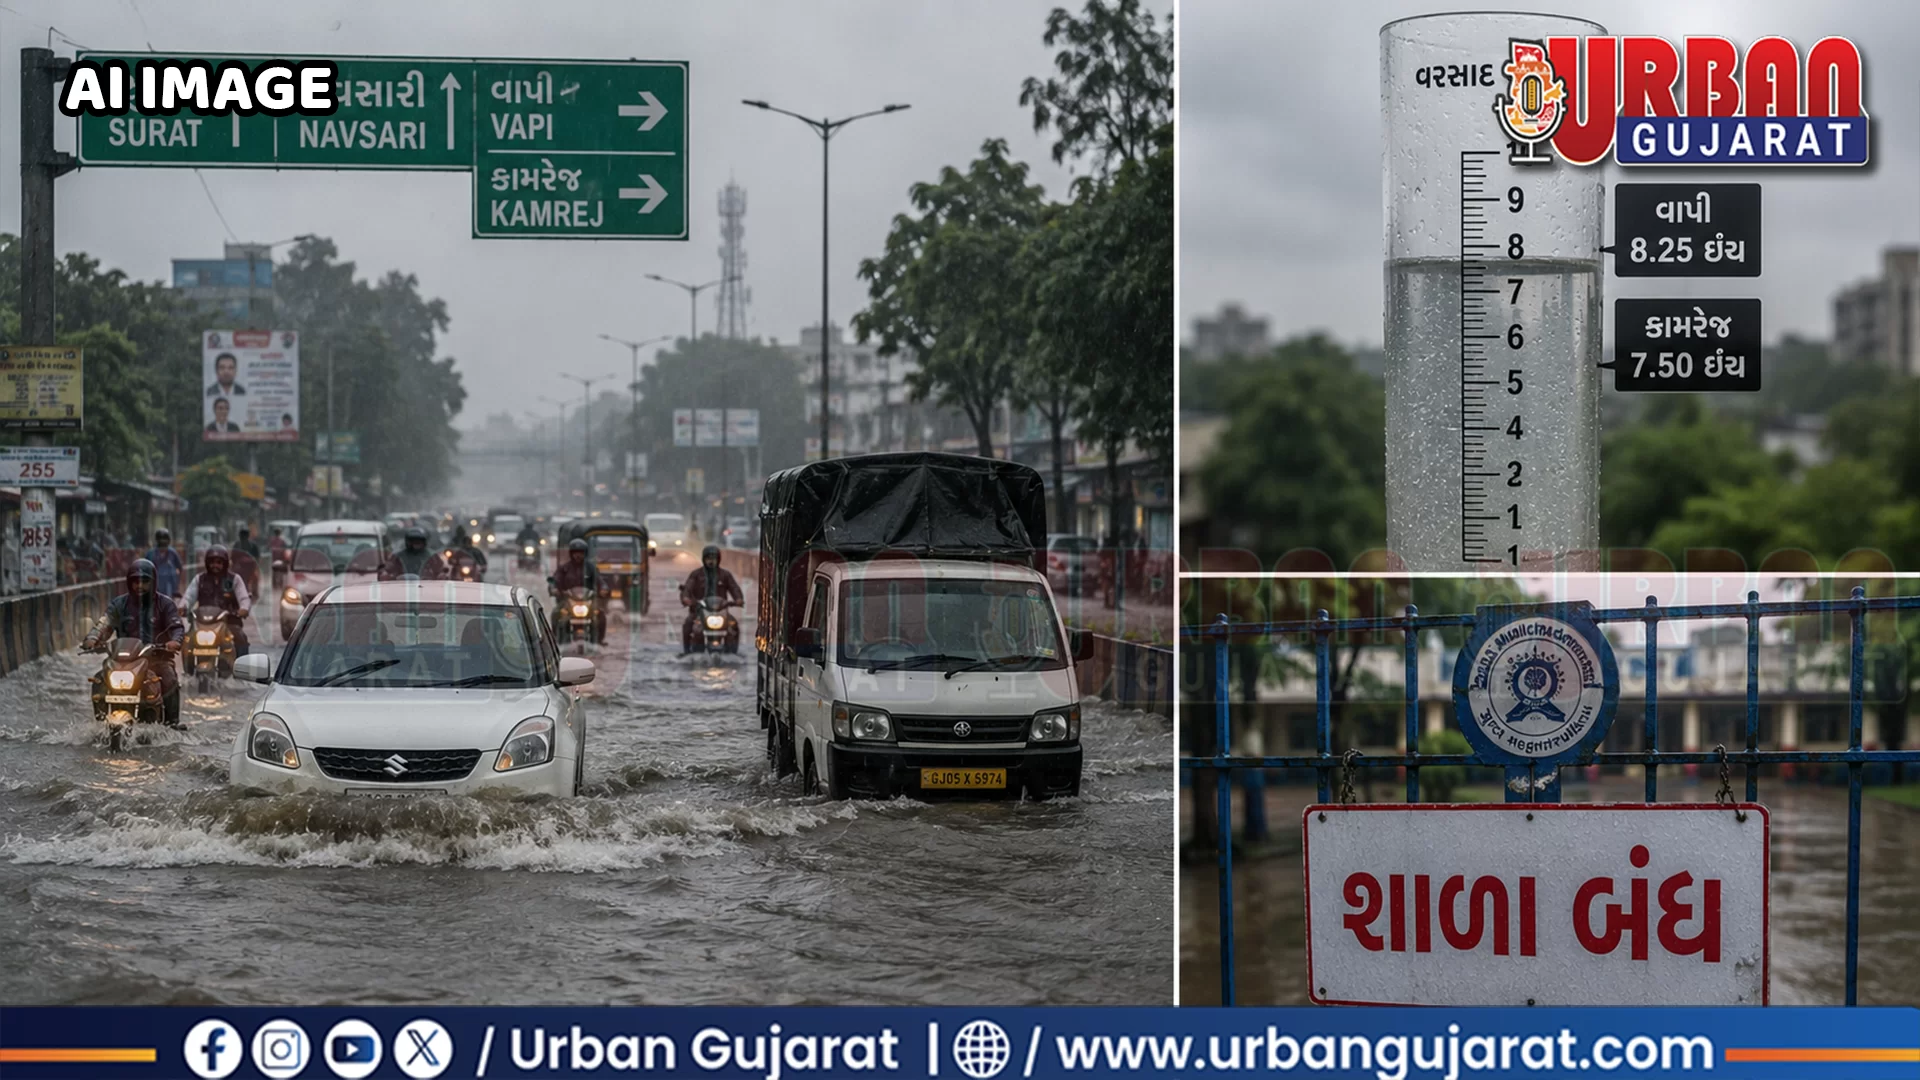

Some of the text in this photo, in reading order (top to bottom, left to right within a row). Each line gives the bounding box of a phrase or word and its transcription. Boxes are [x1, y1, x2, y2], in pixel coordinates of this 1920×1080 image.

[490, 71, 554, 104] વાપી
[1415, 63, 1496, 89] વરસાદ
[108, 117, 203, 147] SURAT
[300, 119, 426, 150] NAVSARI
[490, 113, 553, 141] VAPI
[490, 158, 583, 192] કામરેજ
[1507, 186, 1524, 213] 9
[1655, 191, 1711, 223] વાપી
[490, 199, 604, 228] KAMREJ
[1507, 233, 1524, 260] 8
[1630, 236, 1693, 263] 8.25
[1507, 278, 1524, 305] 7
[1644, 306, 1732, 338] કામરેજ
[1507, 323, 1524, 350] 6
[1630, 351, 1693, 378] 7.50
[1507, 369, 1524, 396] 5
[1507, 415, 1524, 440] 4
[1507, 460, 1524, 488] 2
[1507, 504, 1524, 530] 1
[1507, 544, 1524, 567] 1
[963, 772, 971, 785] X
[1342, 844, 1722, 963] શાળા બંધ
